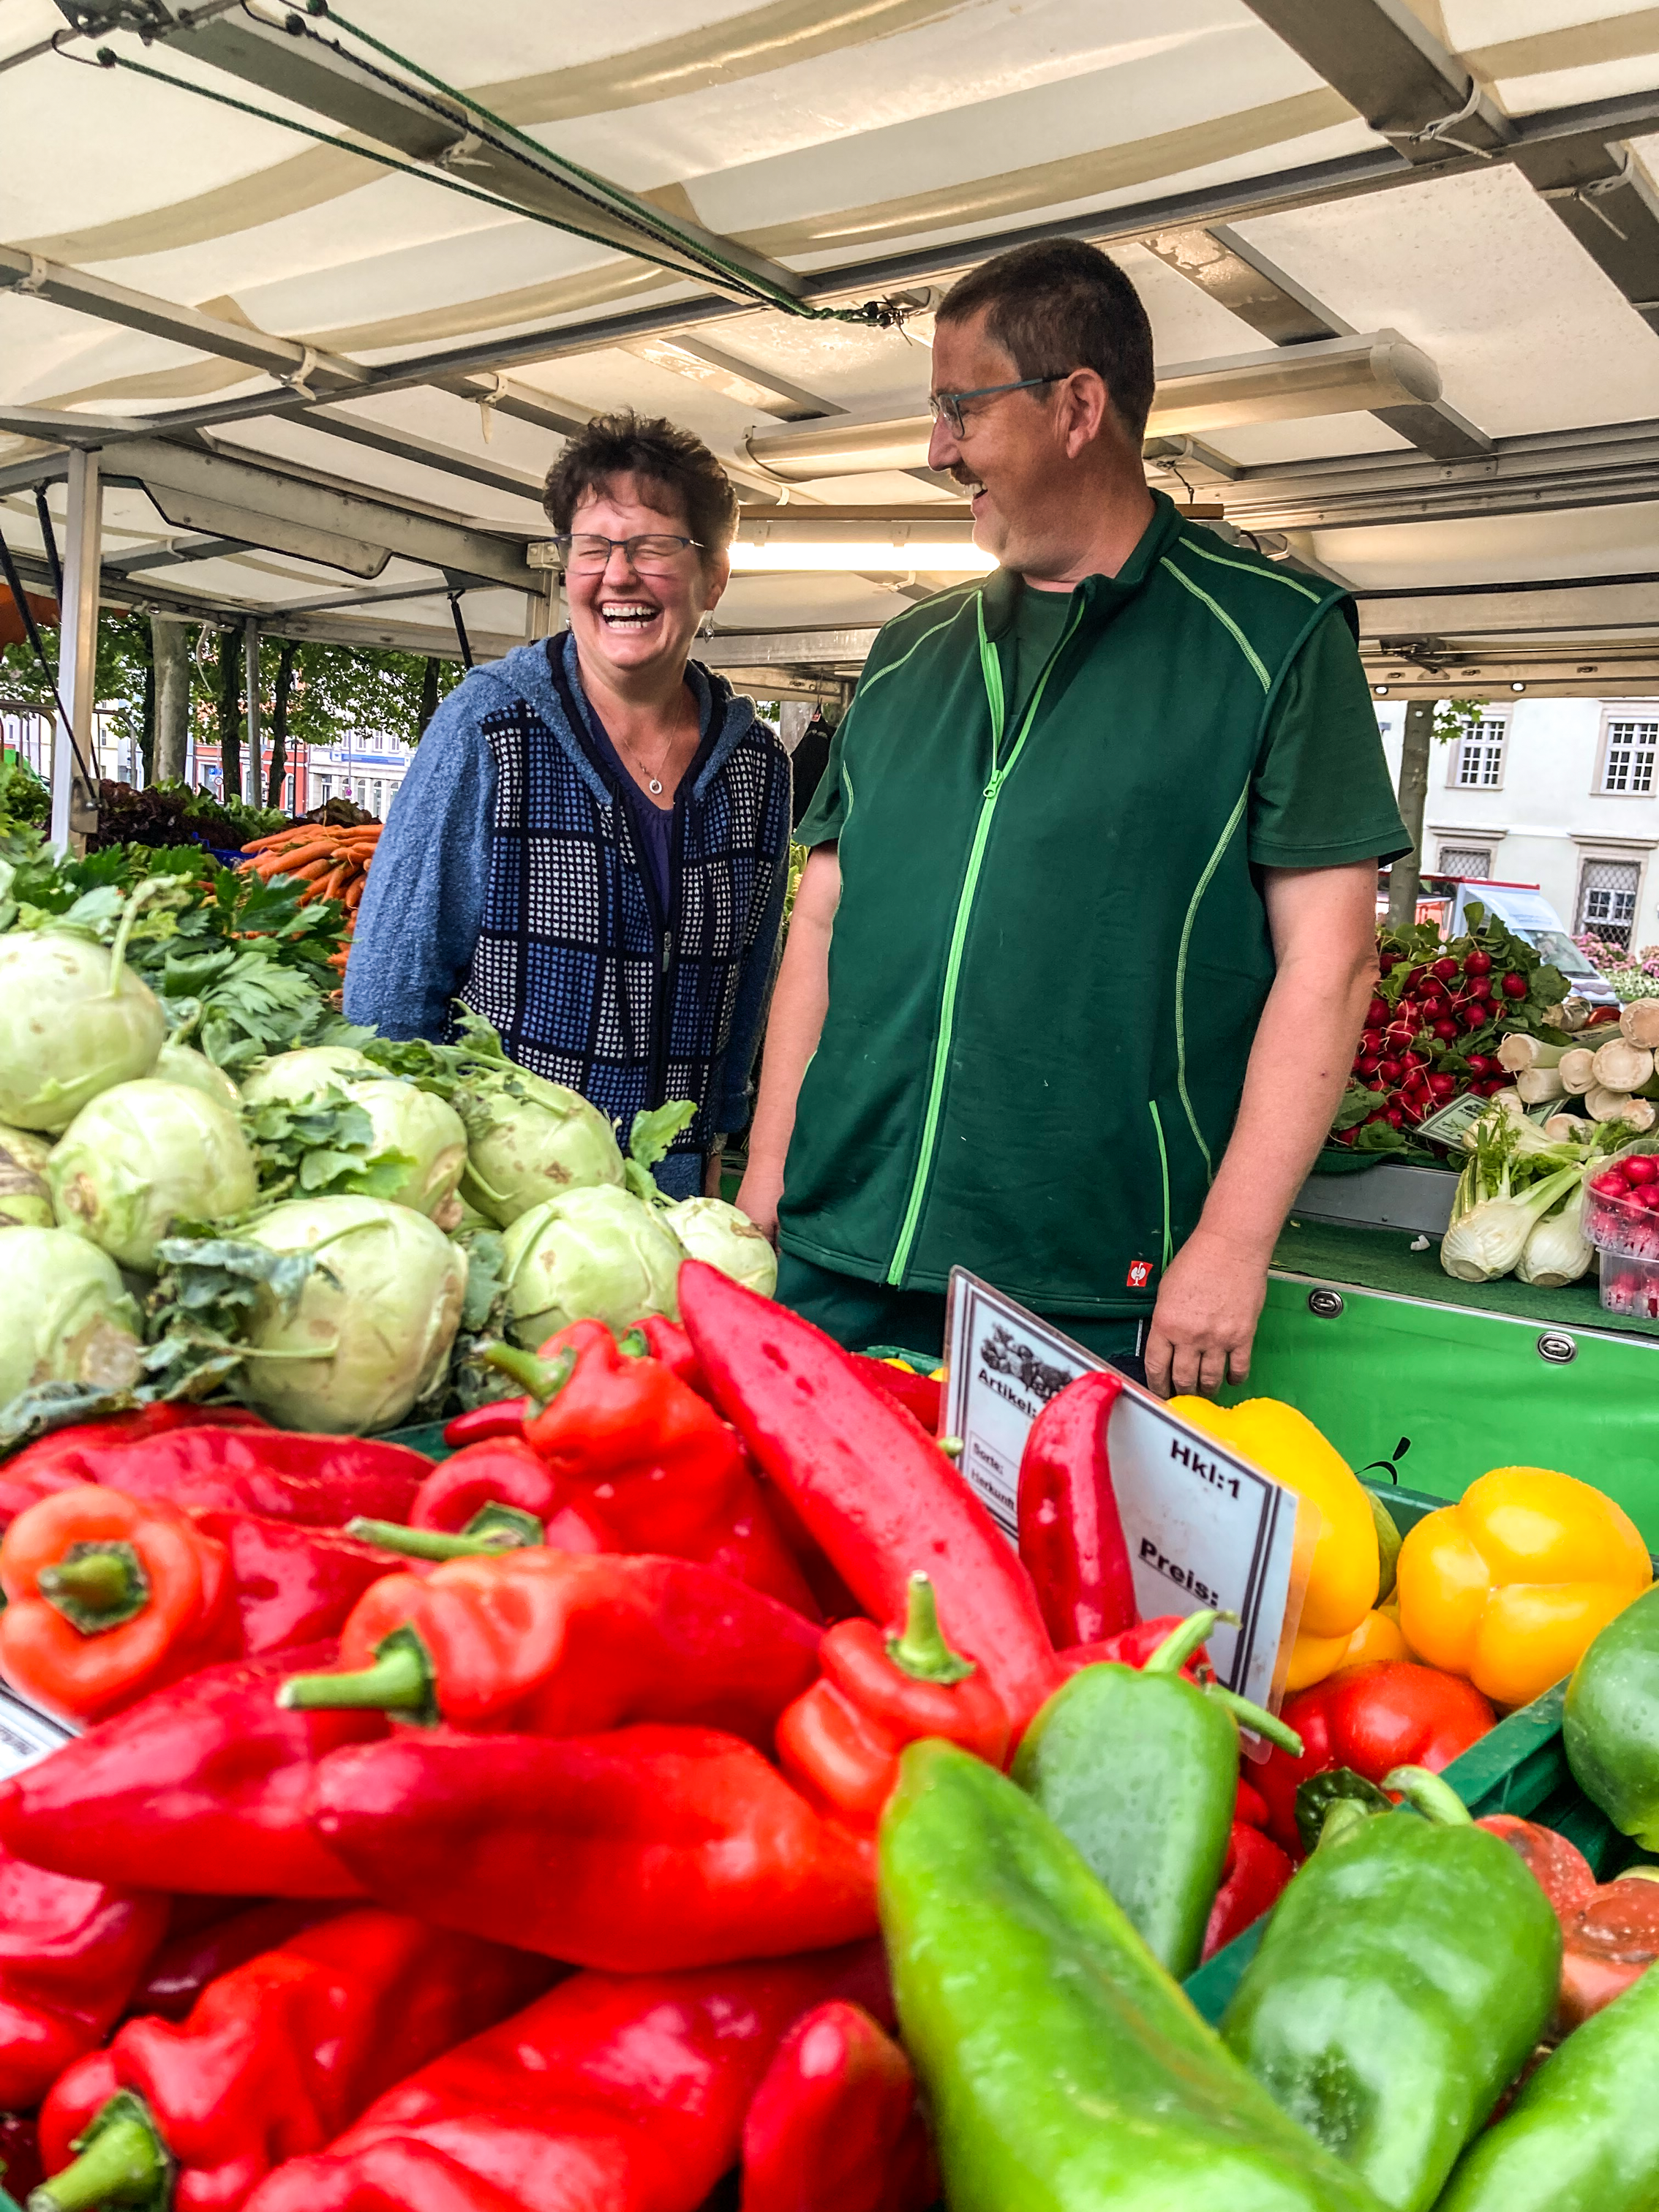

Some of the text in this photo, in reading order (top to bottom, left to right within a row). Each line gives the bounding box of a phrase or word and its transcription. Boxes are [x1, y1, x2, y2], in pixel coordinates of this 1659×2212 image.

[979, 1369, 1037, 1418] Artikel:
[974, 1443, 1004, 1475] Sorte:
[1170, 1438, 1241, 1499] Hkl:1
[1140, 1538, 1219, 1607] Preis:
